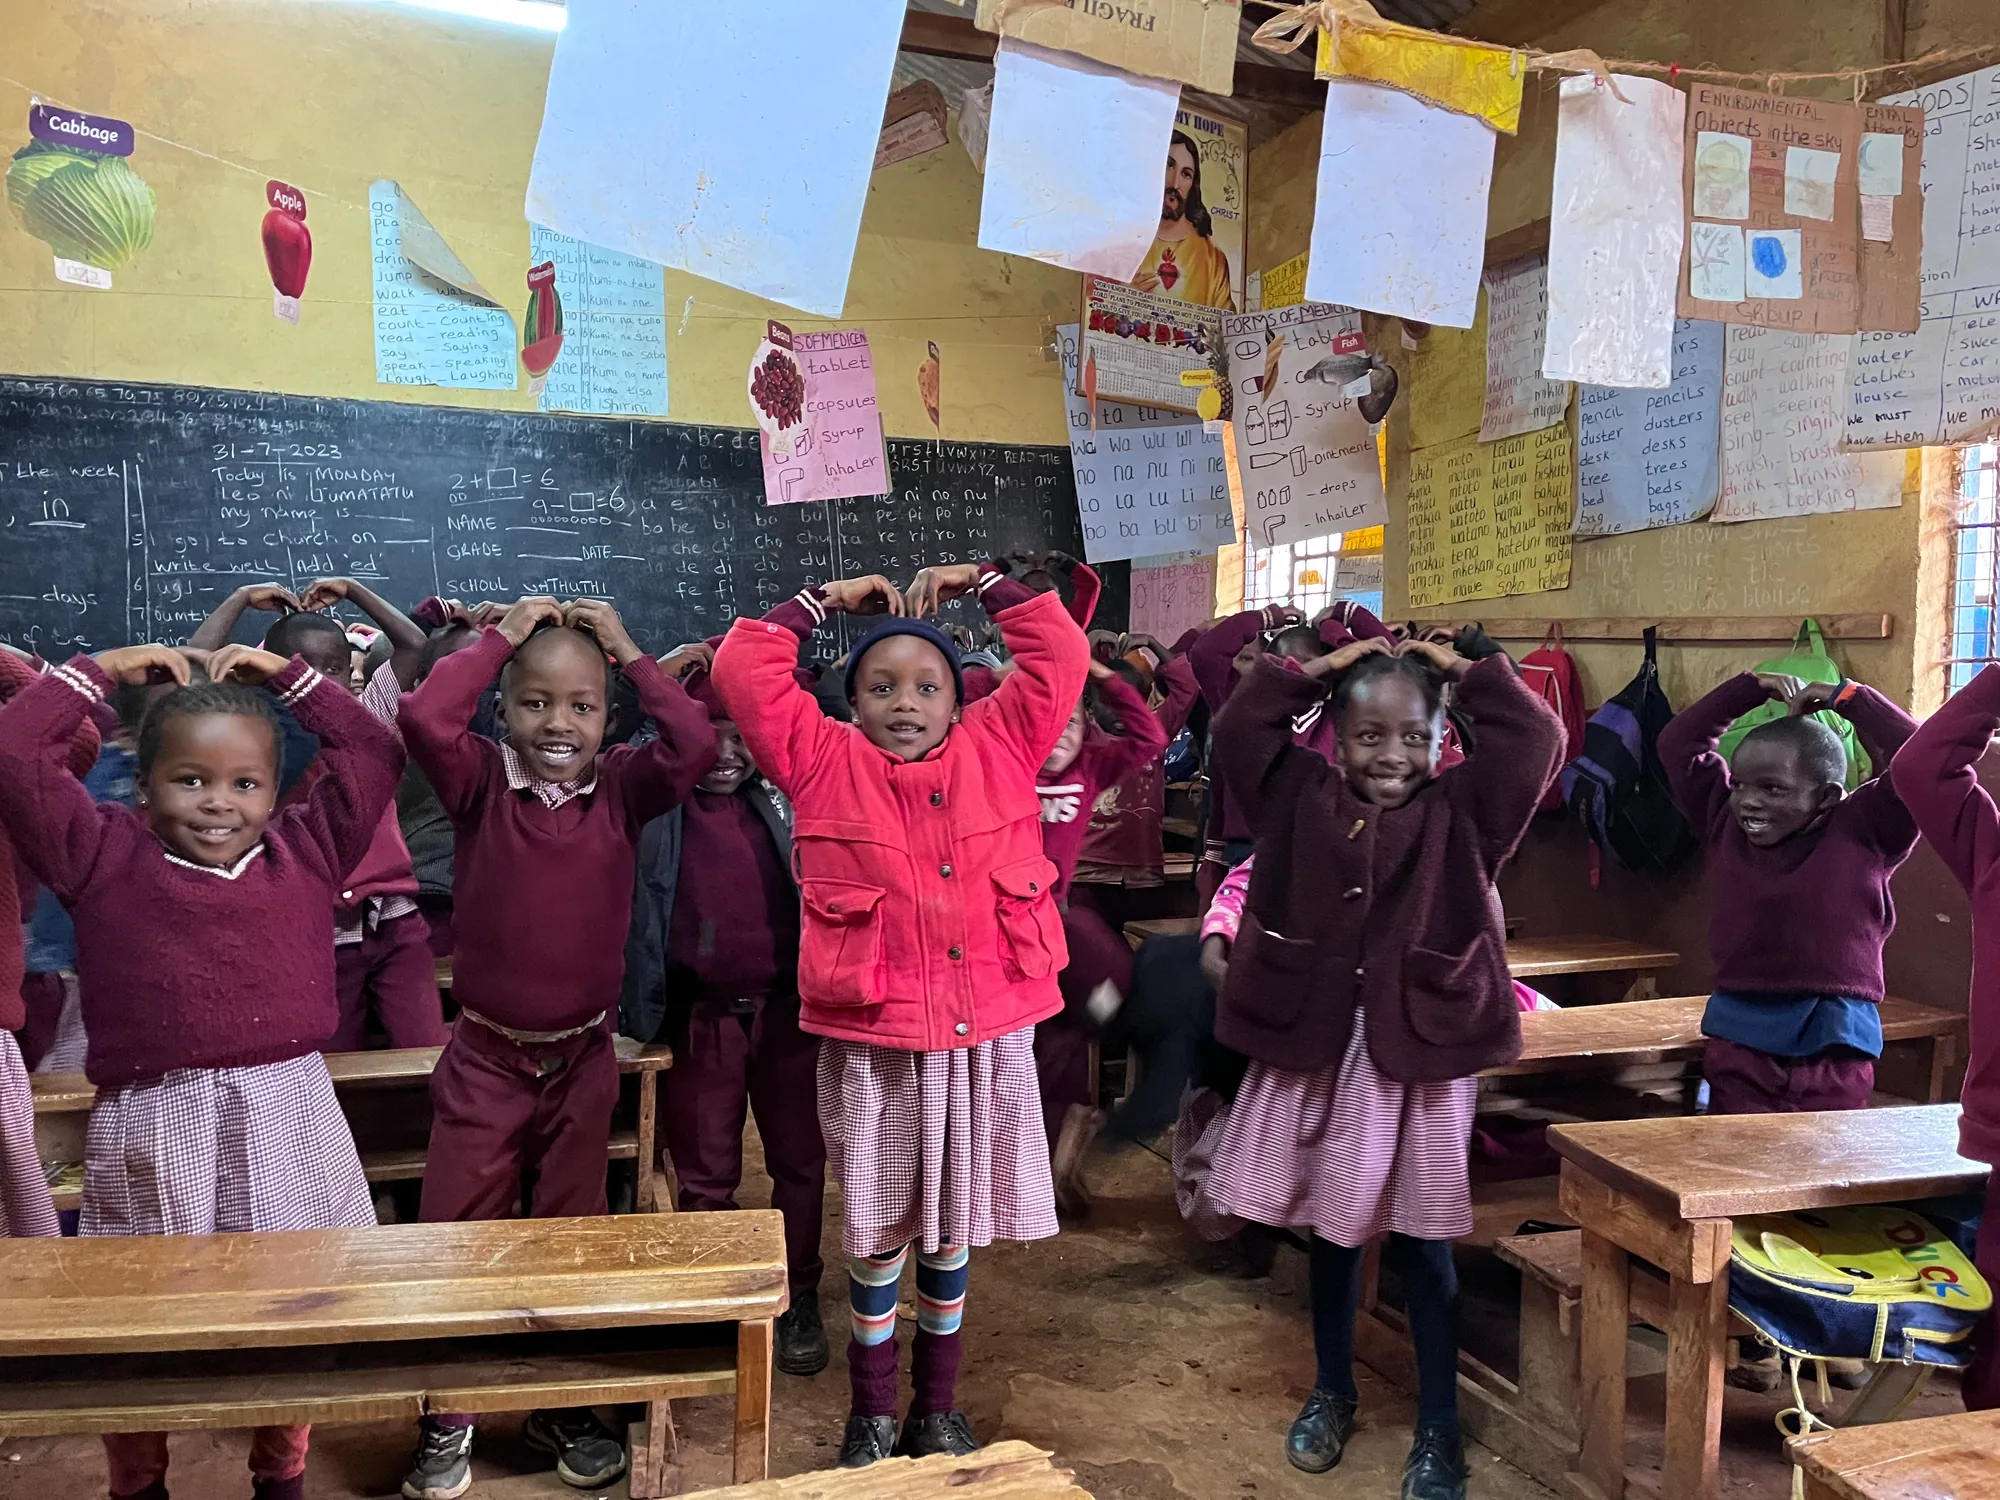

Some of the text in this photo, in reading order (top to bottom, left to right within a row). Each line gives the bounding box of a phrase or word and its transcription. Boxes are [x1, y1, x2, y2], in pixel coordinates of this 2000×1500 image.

[49, 115, 118, 144] Cabbage
[1194, 115, 1224, 137] HOPE
[1695, 111, 1760, 137] Objects
[274, 189, 301, 212] Apple
[372, 202, 393, 217] go
[1210, 206, 1240, 220] CHRIST
[378, 306, 408, 316] eat
[378, 320, 424, 329] count
[1226, 309, 1295, 334] FORMS OF
[379, 328, 499, 342] read reading
[1341, 337, 1358, 348] Fish
[382, 349, 407, 359] say
[1858, 349, 1914, 366] water
[385, 362, 426, 372] speak
[1070, 408, 1123, 427] to ta
[1644, 410, 1703, 431] dusters
[1581, 427, 1624, 446] duster
[1642, 436, 1686, 455] desks
[1846, 431, 1924, 445] have them
[1005, 451, 1061, 465] READ THE
[1580, 452, 1687, 475] desk trees
[17, 463, 120, 478] the week
[211, 467, 265, 487] Today
[315, 468, 395, 483] MONDAY
[1077, 457, 1223, 484] no na nu ni ne
[1320, 479, 1357, 496] drops
[1581, 472, 1682, 495] tree beds
[964, 489, 987, 500] nu
[43, 490, 69, 519] in
[262, 506, 316, 519] name
[1582, 493, 1680, 515] bed bags
[447, 514, 497, 531] NAME
[1085, 514, 1201, 540] bo ba bu bi
[1580, 512, 1603, 525] bag
[218, 531, 247, 545] to
[263, 530, 338, 545] church
[352, 532, 377, 543] on
[447, 544, 611, 560] GRADE DATE
[1452, 545, 1479, 564] tena
